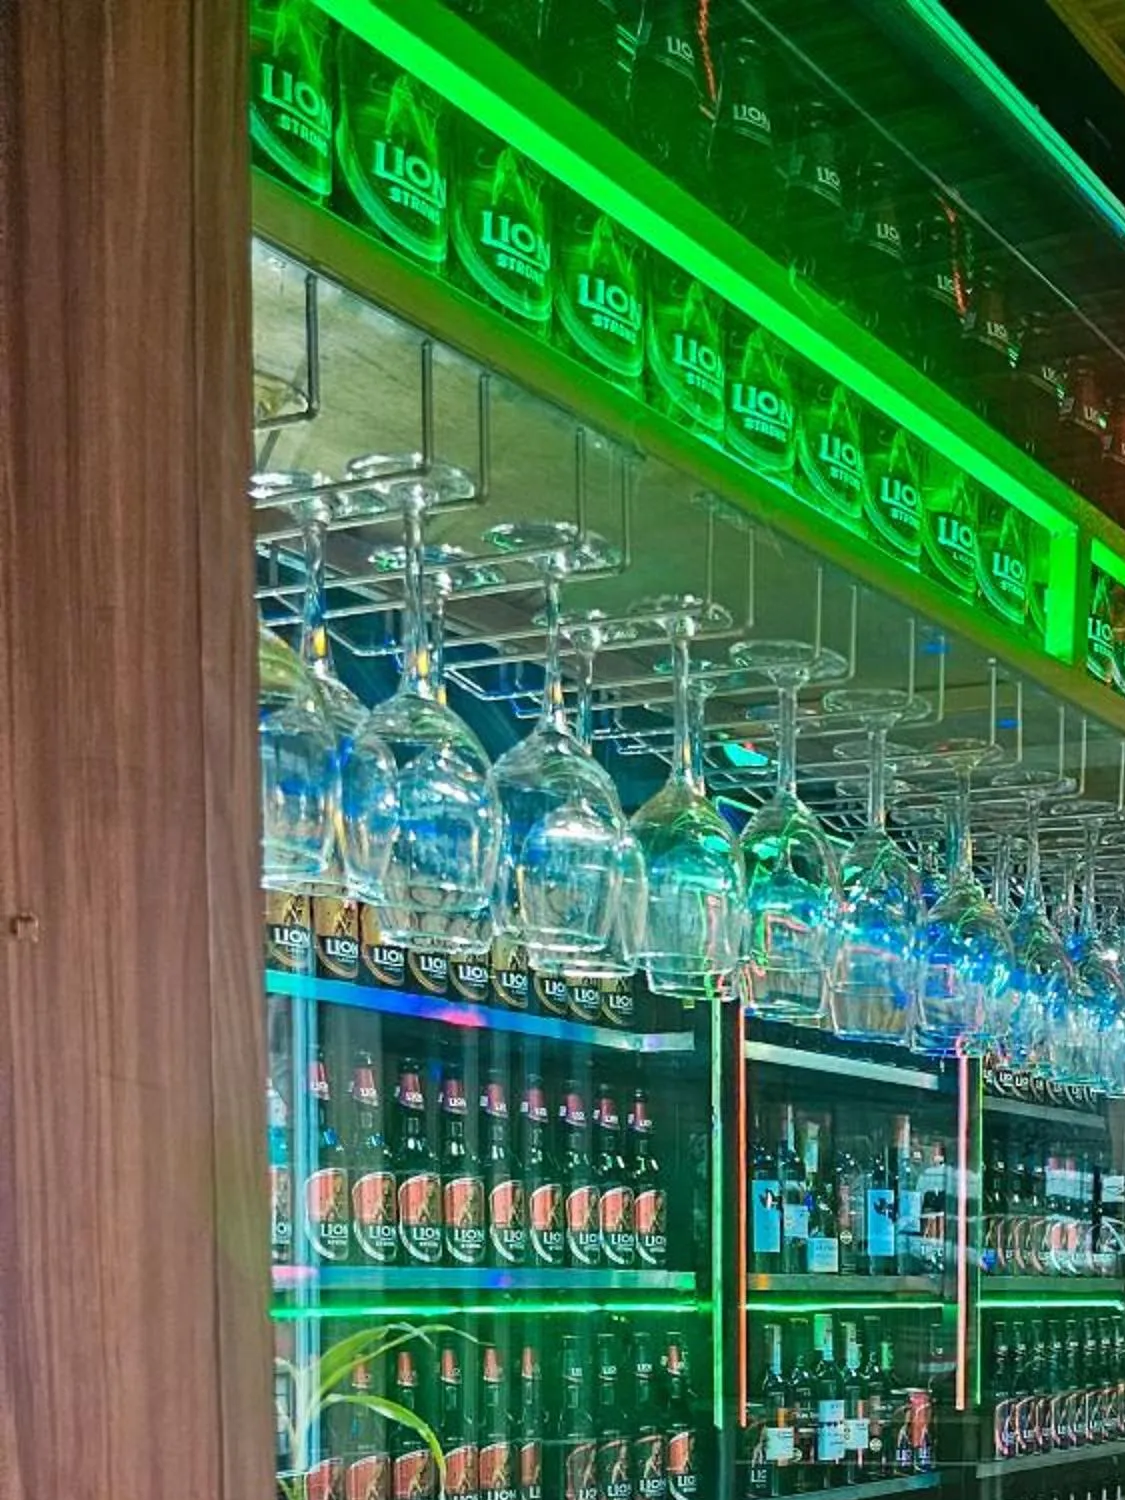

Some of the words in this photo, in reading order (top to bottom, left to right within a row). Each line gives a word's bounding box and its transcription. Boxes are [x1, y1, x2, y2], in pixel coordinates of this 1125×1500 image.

[667, 35, 696, 67] LIO
[372, 140, 447, 208] LION
[816, 166, 842, 193] LIO
[480, 210, 550, 271] LION
[876, 223, 900, 246] LIO
[577, 273, 642, 331] LION
[732, 383, 794, 430] LION
[880, 477, 921, 519] LIO
[938, 516, 977, 558] LIO
[992, 552, 1027, 589] LIO
[1087, 617, 1113, 648] LIO
[545, 979, 567, 995] LIO
